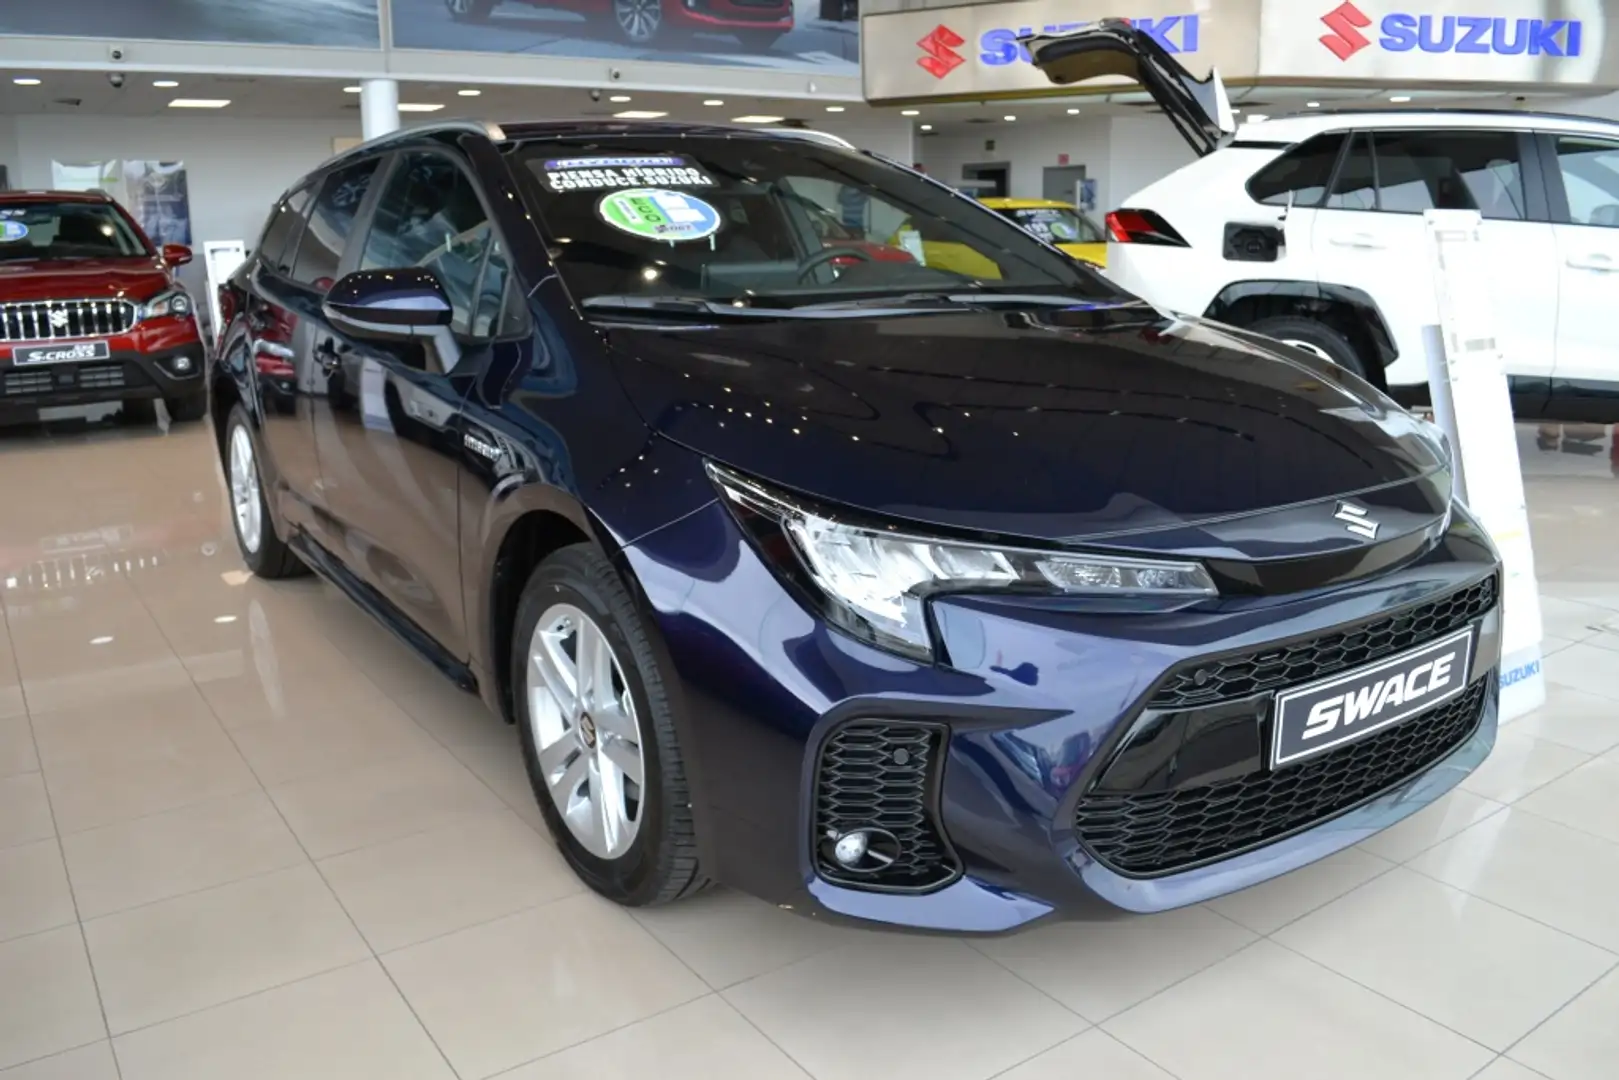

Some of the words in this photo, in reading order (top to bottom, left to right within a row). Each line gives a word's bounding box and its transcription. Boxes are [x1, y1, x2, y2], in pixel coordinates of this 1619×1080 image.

[1379, 13, 1582, 56] SUZUKI
[547, 169, 618, 180] PIENSA
[550, 176, 642, 189] CONDUCE
[646, 174, 713, 185] SUZUKI
[630, 198, 661, 223] ECO
[1302, 652, 1455, 739] SWACE
